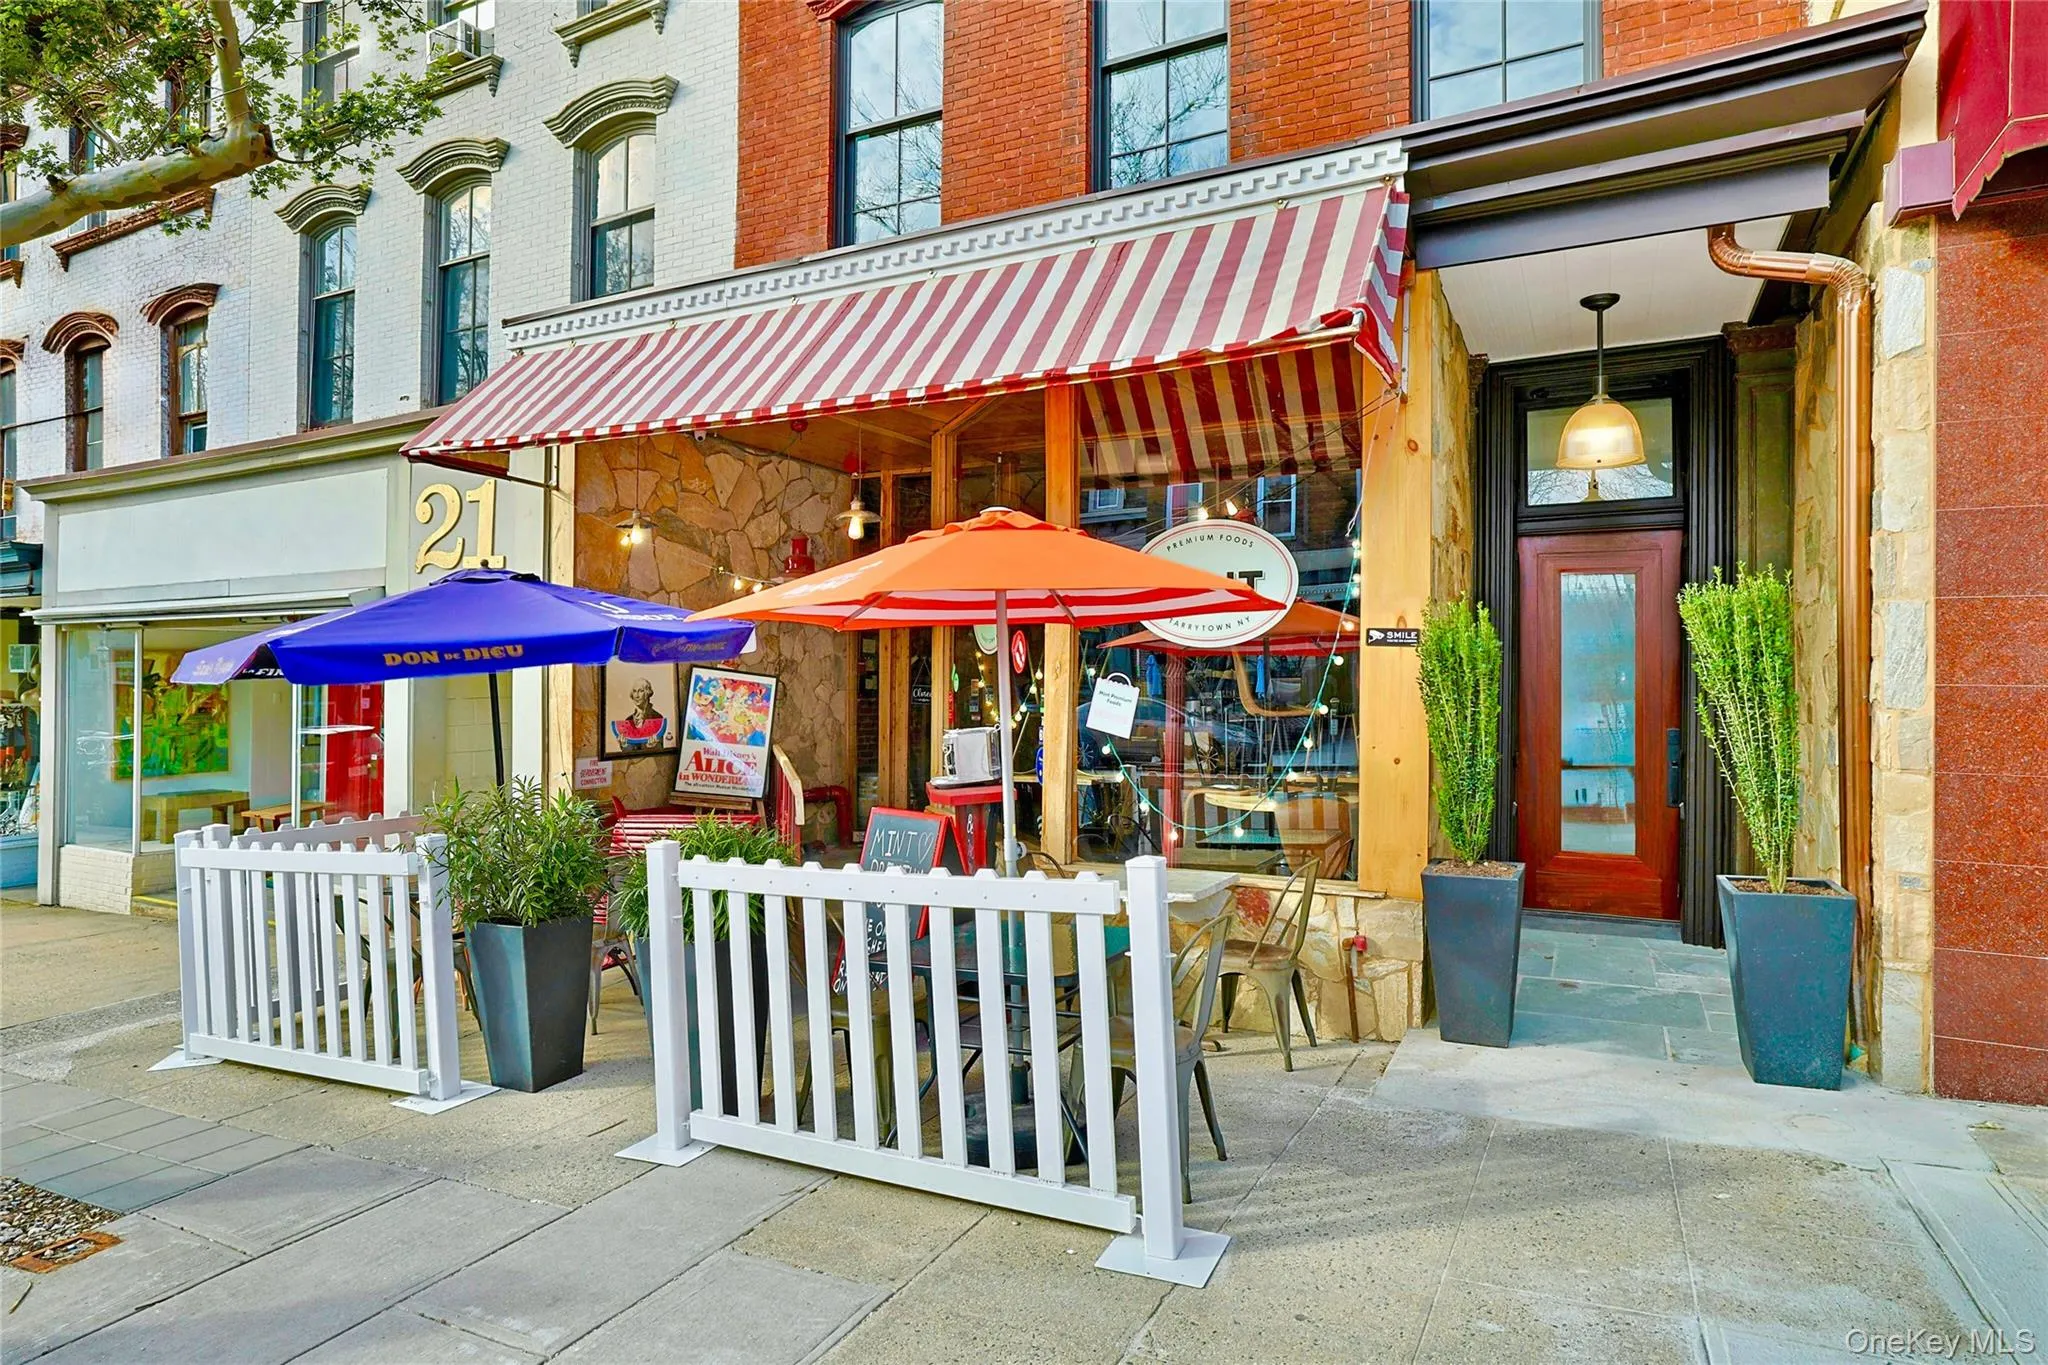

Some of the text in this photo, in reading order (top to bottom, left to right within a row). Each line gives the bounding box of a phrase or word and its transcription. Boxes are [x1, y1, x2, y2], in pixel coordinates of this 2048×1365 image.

[416, 479, 506, 574] 21
[1166, 534, 1255, 552] PREMIUM FOODS
[1168, 616, 1252, 632] TARRYTOWN NY
[1386, 631, 1418, 639] SMILE
[383, 650, 440, 666] DON
[679, 772, 690, 781] in
[869, 828, 918, 857] MINT
